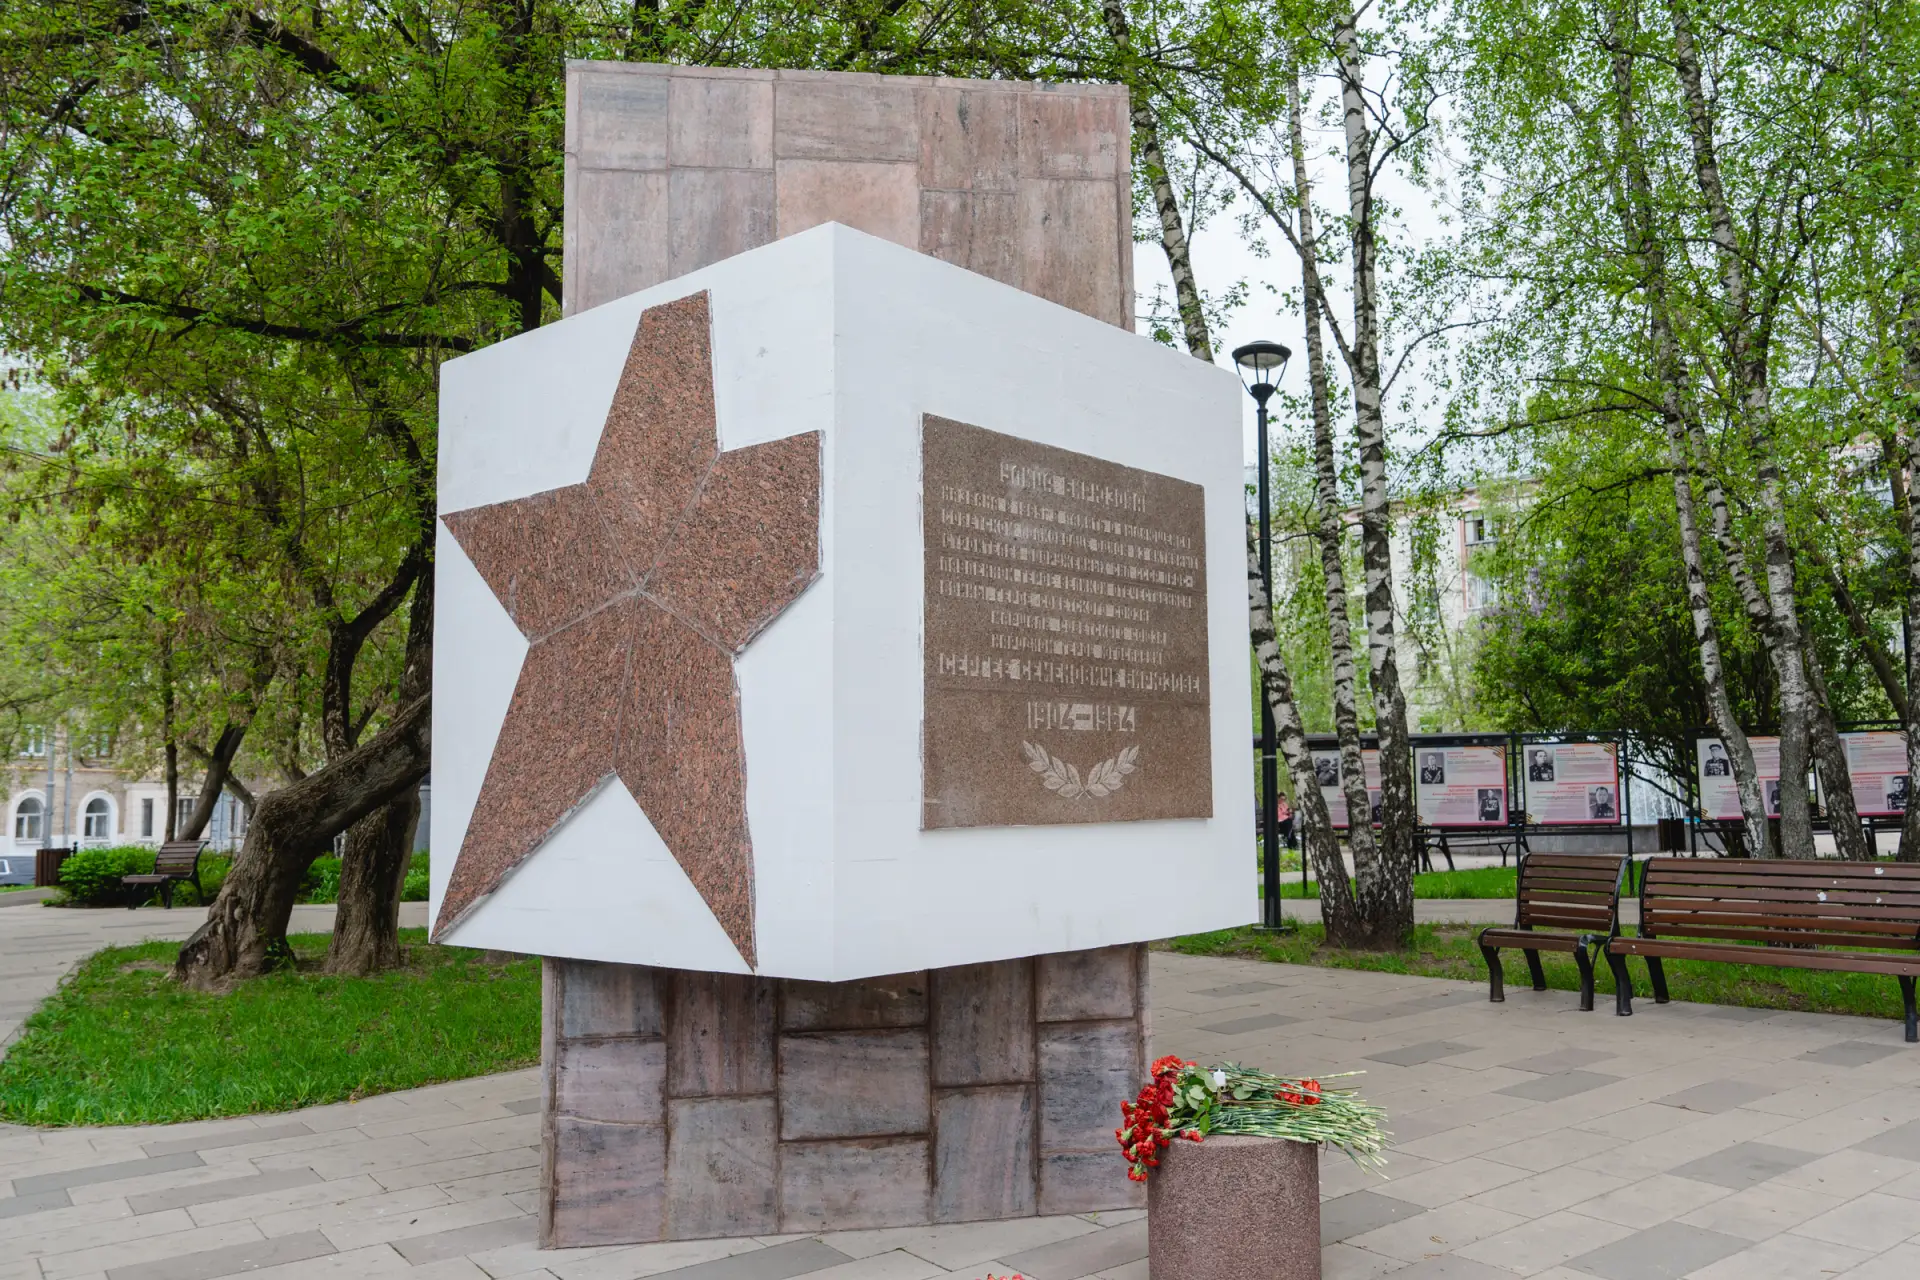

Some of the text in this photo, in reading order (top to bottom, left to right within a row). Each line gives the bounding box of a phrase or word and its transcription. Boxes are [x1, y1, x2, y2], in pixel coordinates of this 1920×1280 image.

[1001, 461, 1145, 514] УЛИЦА БИРЮЗОВА
[941, 653, 1200, 693] СЕРГЕЕ СЕМЕНОВИЧЕ БИРЮЗОВЕ
